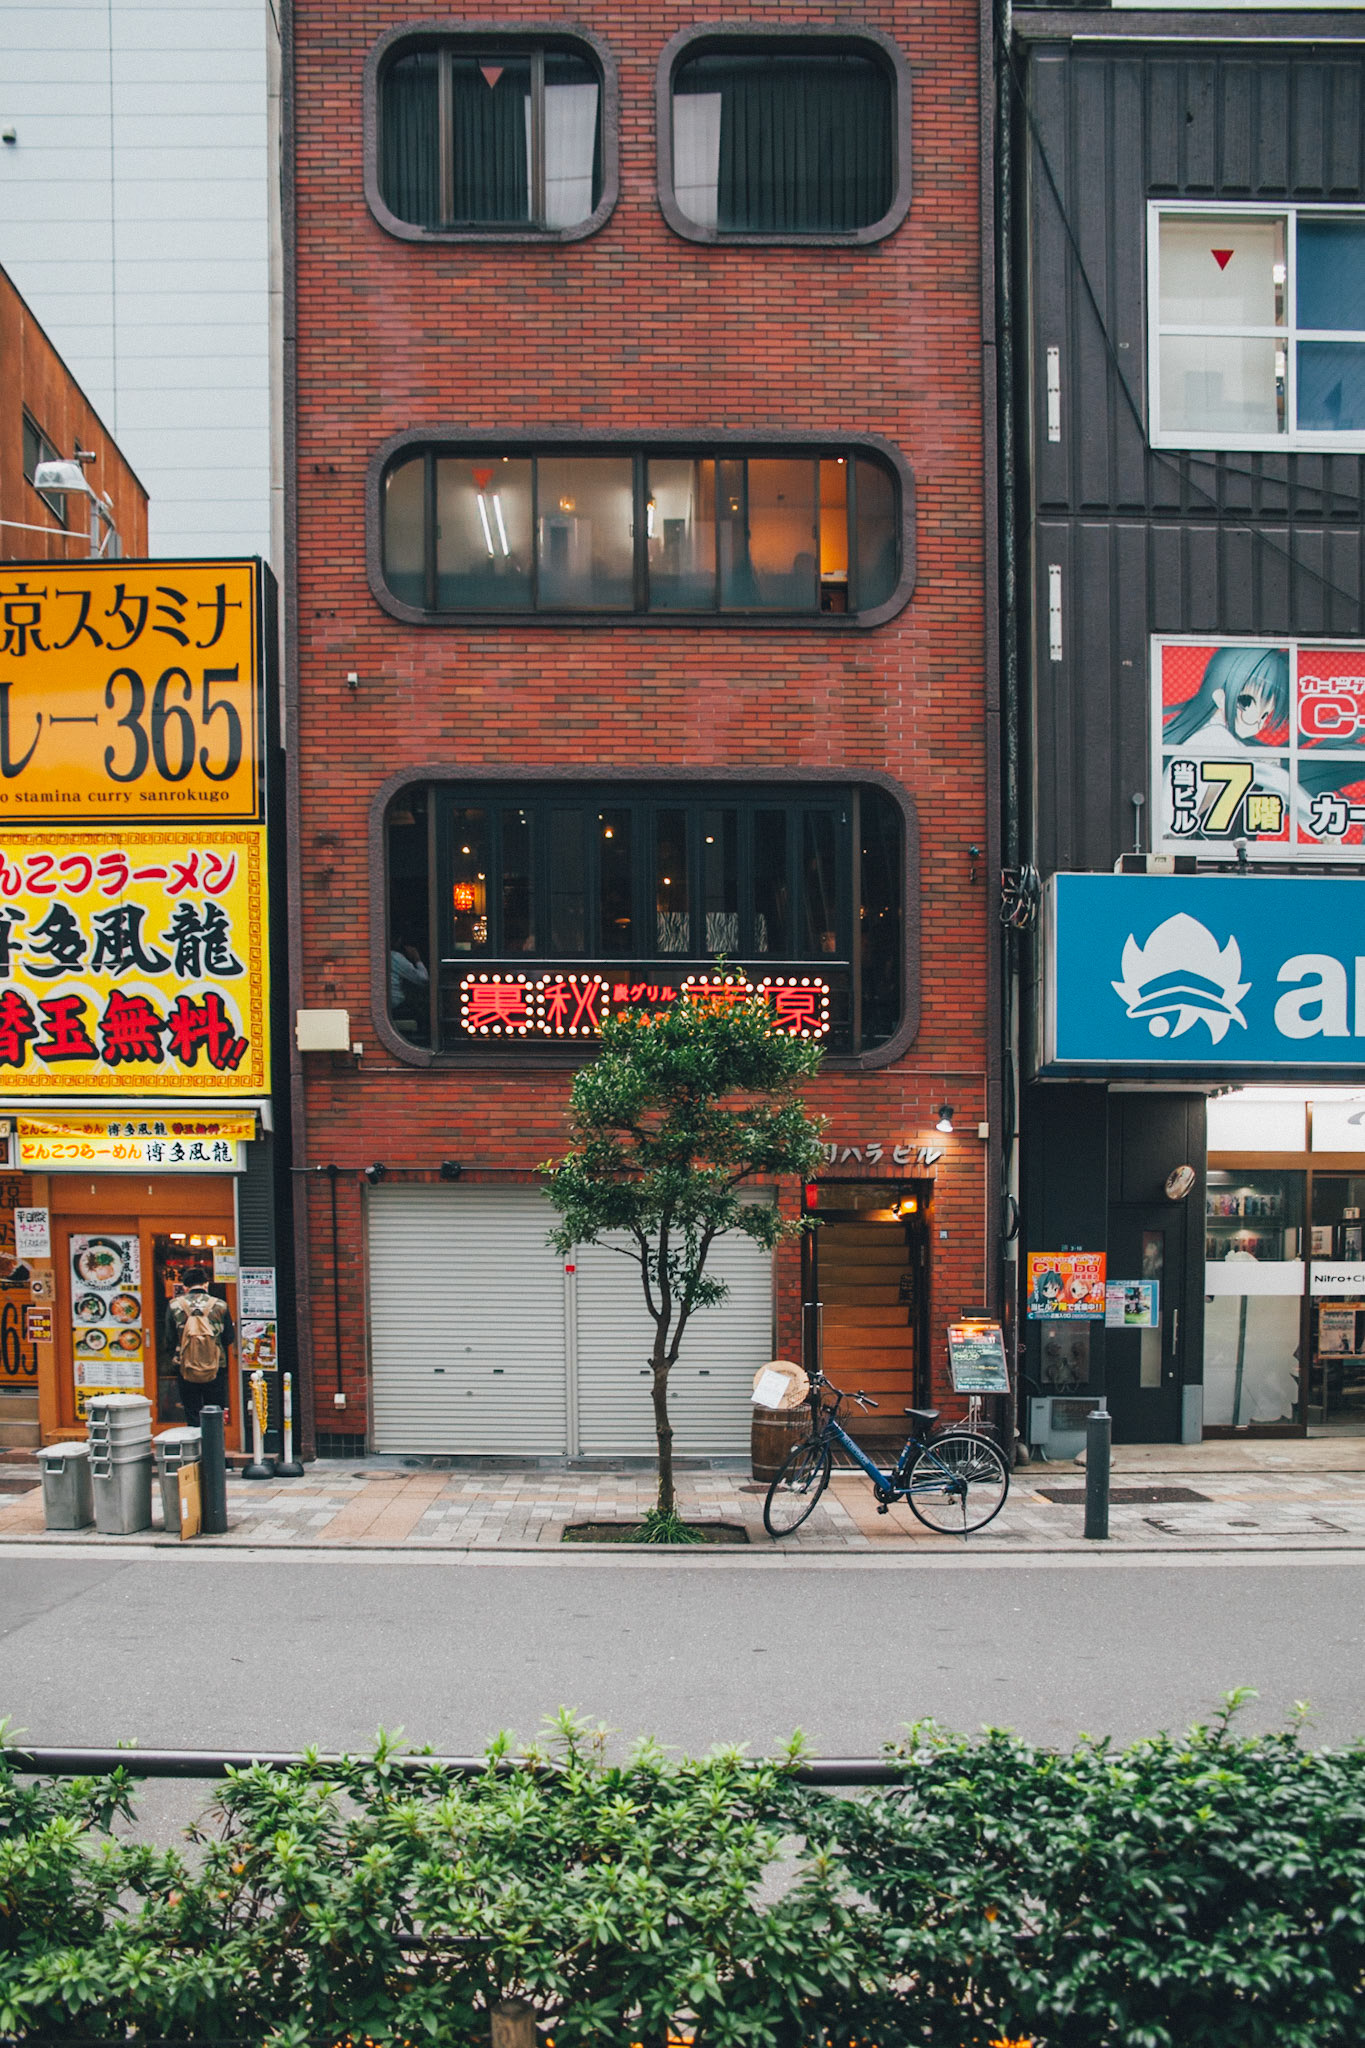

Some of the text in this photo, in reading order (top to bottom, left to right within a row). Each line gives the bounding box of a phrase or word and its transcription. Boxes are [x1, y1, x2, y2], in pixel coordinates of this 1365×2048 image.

[0, 583, 242, 656] 京スタミナ
[15, 789, 82, 802] stamina
[88, 792, 131, 803] curry
[140, 788, 229, 803] sanrokugo
[1171, 761, 1284, 833] 当ビル 7階
[467, 981, 600, 1030] 裏秋
[107, 1122, 168, 1137] 博多風龍
[21, 1143, 142, 1159] とんこつらーめん
[146, 1140, 233, 1162] 博多風龍
